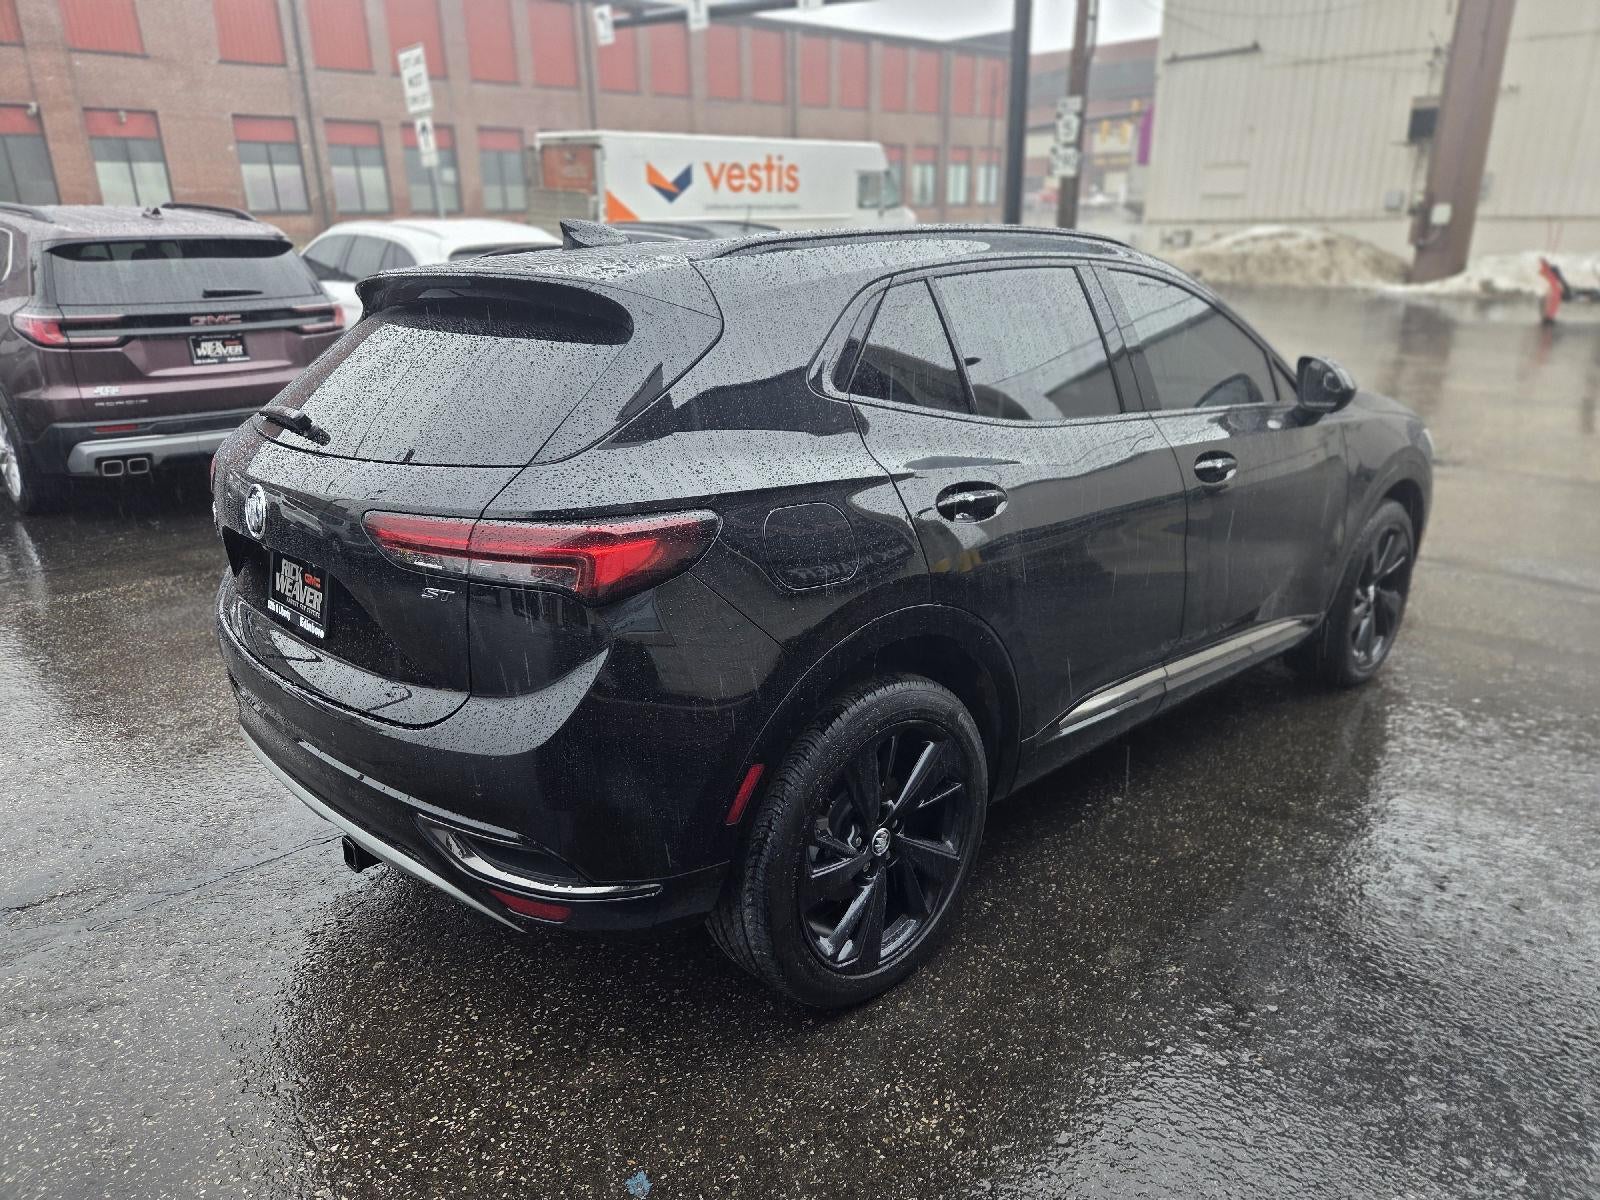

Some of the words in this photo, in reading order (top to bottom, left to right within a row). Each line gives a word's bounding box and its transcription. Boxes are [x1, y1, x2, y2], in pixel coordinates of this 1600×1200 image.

[704, 154, 800, 194] vestis
[190, 313, 242, 326] GMC
[281, 558, 303, 582] RICK
[275, 571, 323, 612] WEAVER
[421, 586, 456, 602] ST
